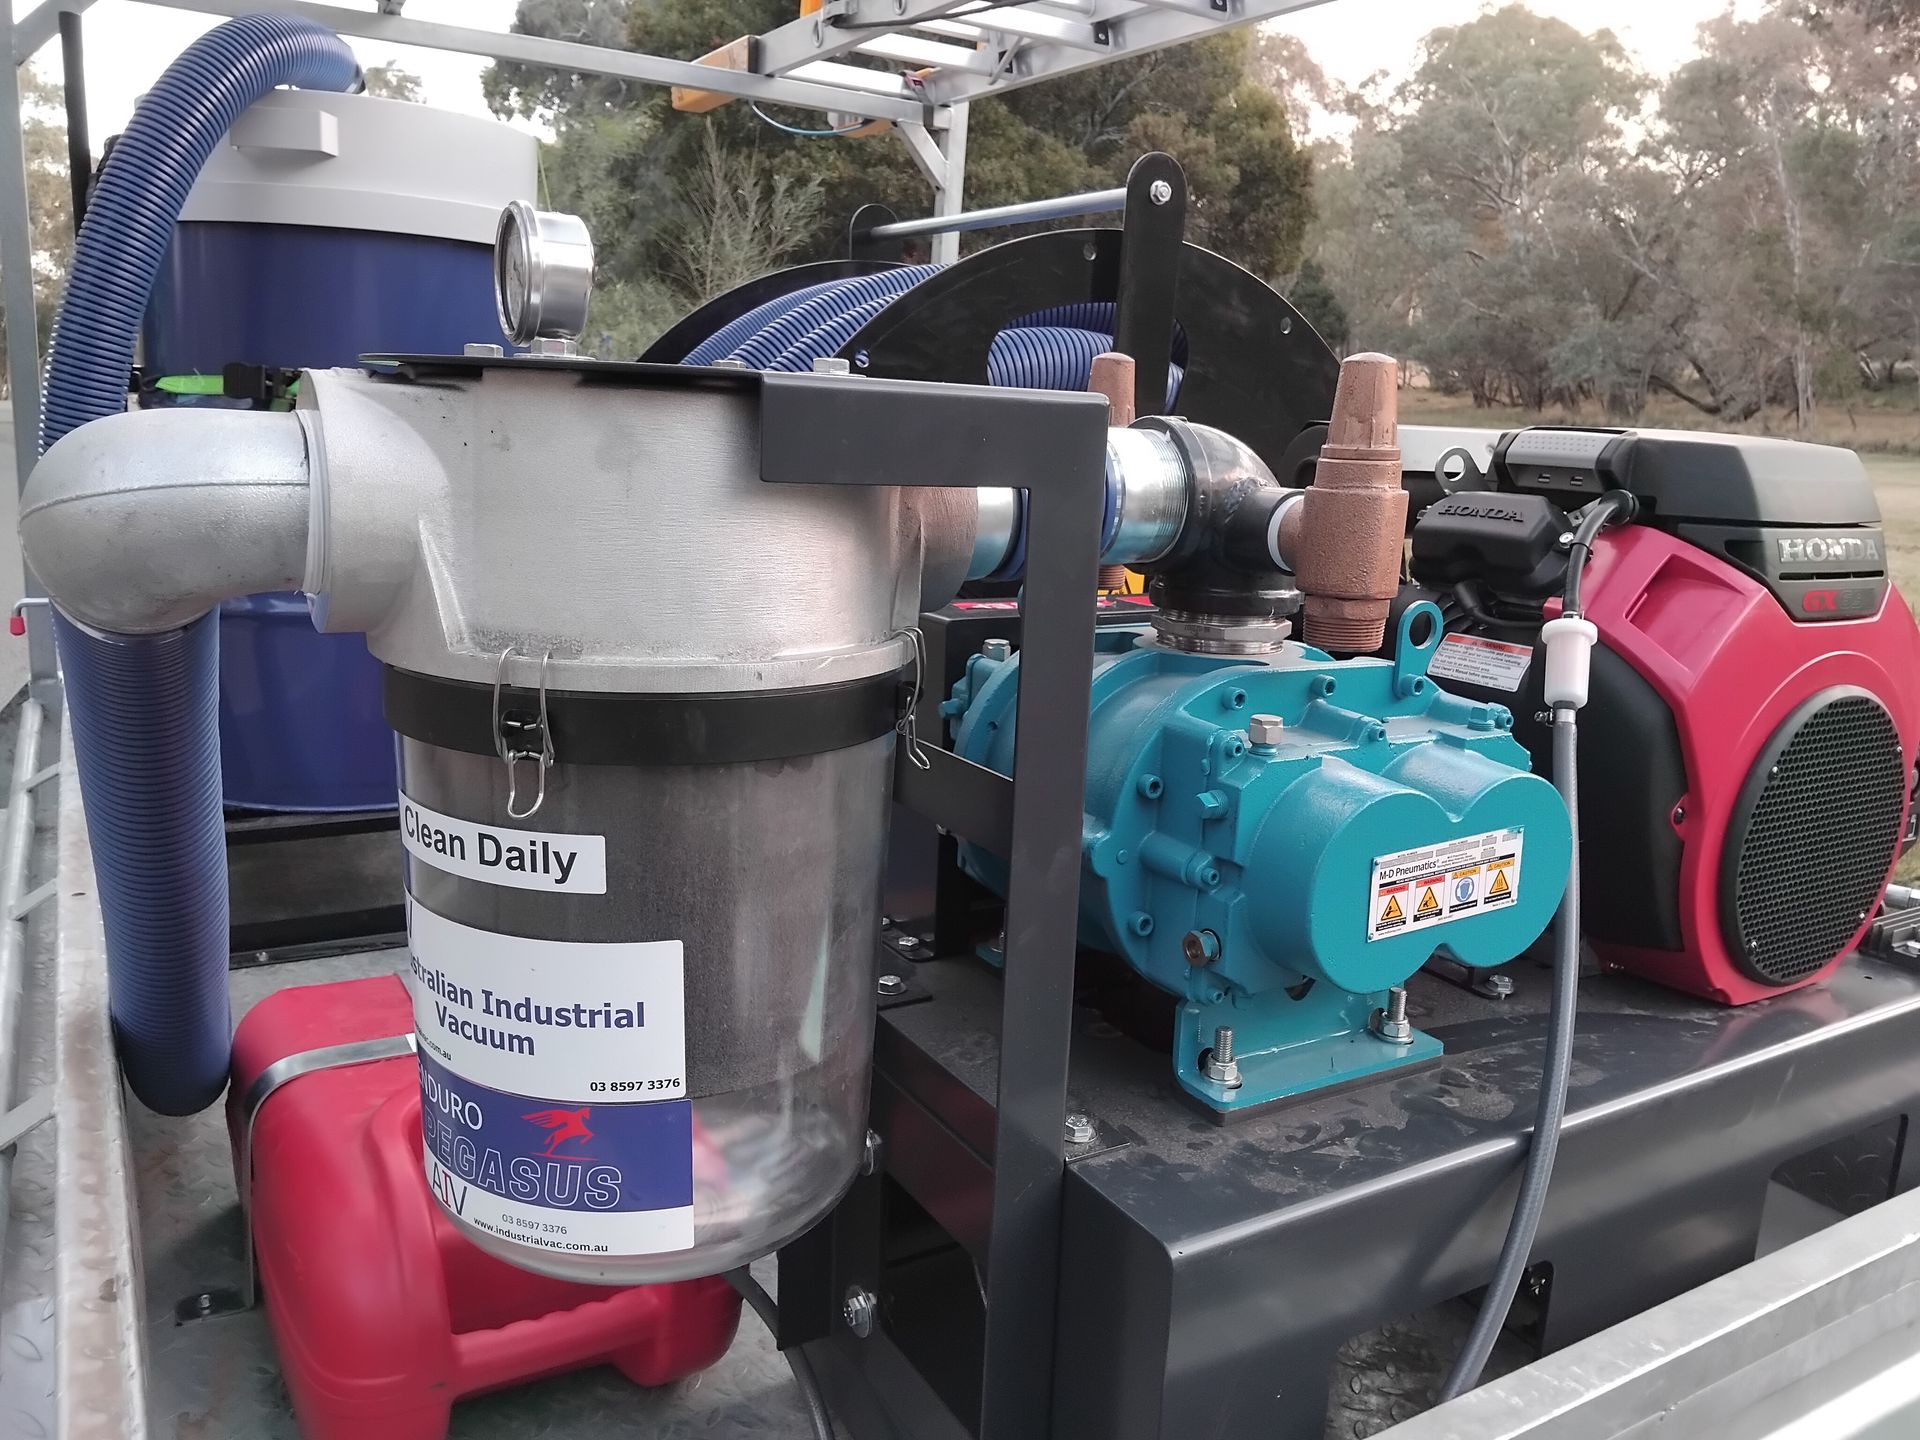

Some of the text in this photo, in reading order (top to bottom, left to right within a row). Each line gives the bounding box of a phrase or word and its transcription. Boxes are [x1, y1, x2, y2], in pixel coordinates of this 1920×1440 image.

[1438, 504, 1524, 523] HONDA
[1778, 537, 1880, 562] HONDA
[404, 805, 578, 885] Clean Daily
[1379, 869, 1395, 881] M-D
[411, 954, 646, 1029] stralian Industrial
[435, 1000, 535, 1056] Vacuum
[589, 1077, 681, 1092] 03 8597 3376
[424, 1104, 623, 1210] PEGASUS
[473, 1216, 609, 1253] www.industrialvac.com.au
[501, 1213, 568, 1236] 03 8597 3376
